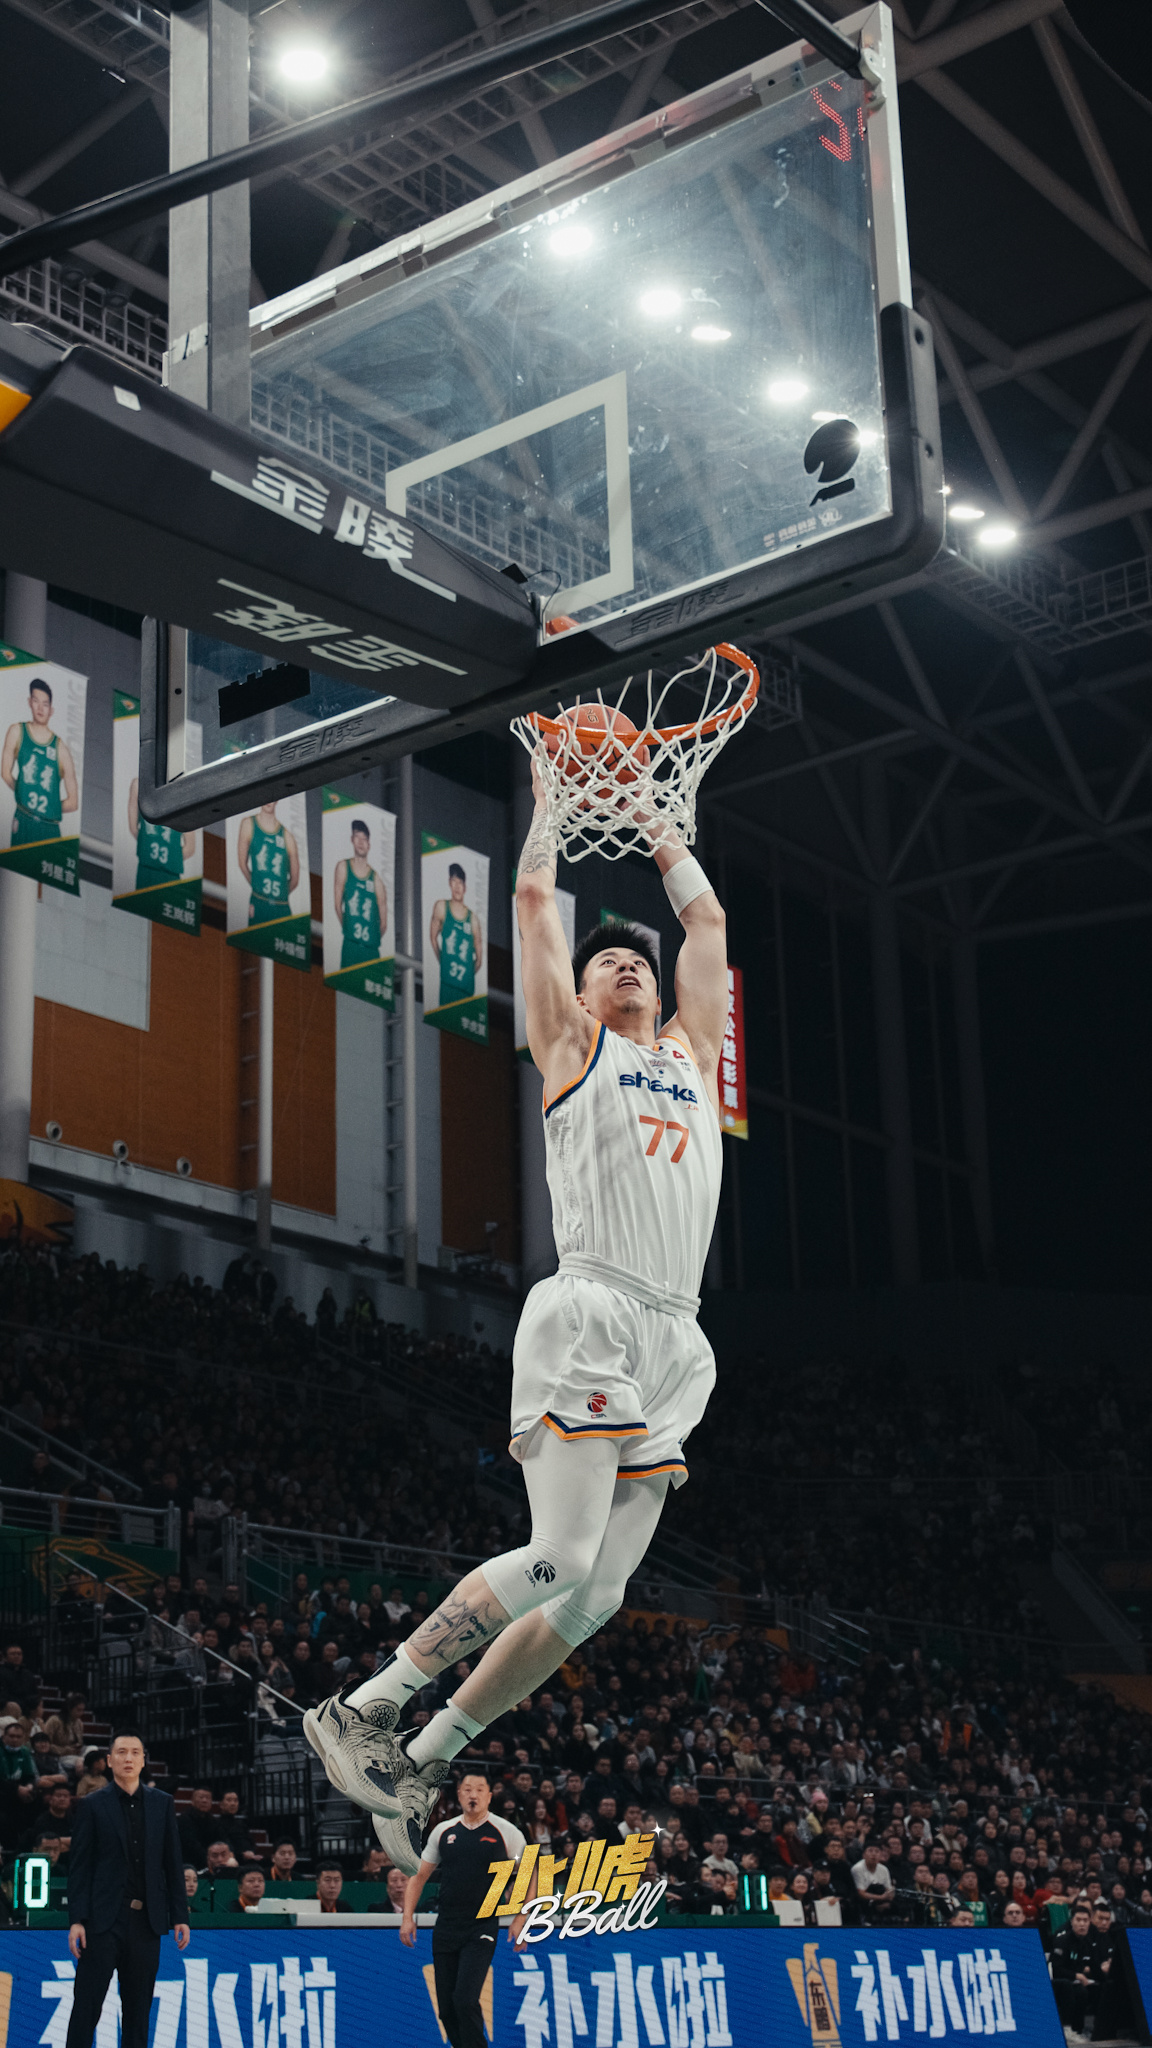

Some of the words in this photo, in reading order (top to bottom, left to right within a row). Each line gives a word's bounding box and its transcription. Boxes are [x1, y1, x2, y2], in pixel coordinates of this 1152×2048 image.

[28, 792, 48, 813] 32
[150, 843, 168, 864] 33
[263, 878, 281, 897] 35
[353, 924, 370, 942] 36
[449, 962, 467, 981] 37
[639, 1115, 690, 1164] 77
[459, 1629, 477, 1642] 7
[513, 1952, 733, 2048] 补水啦
[851, 1949, 1017, 2041] 补水啦
